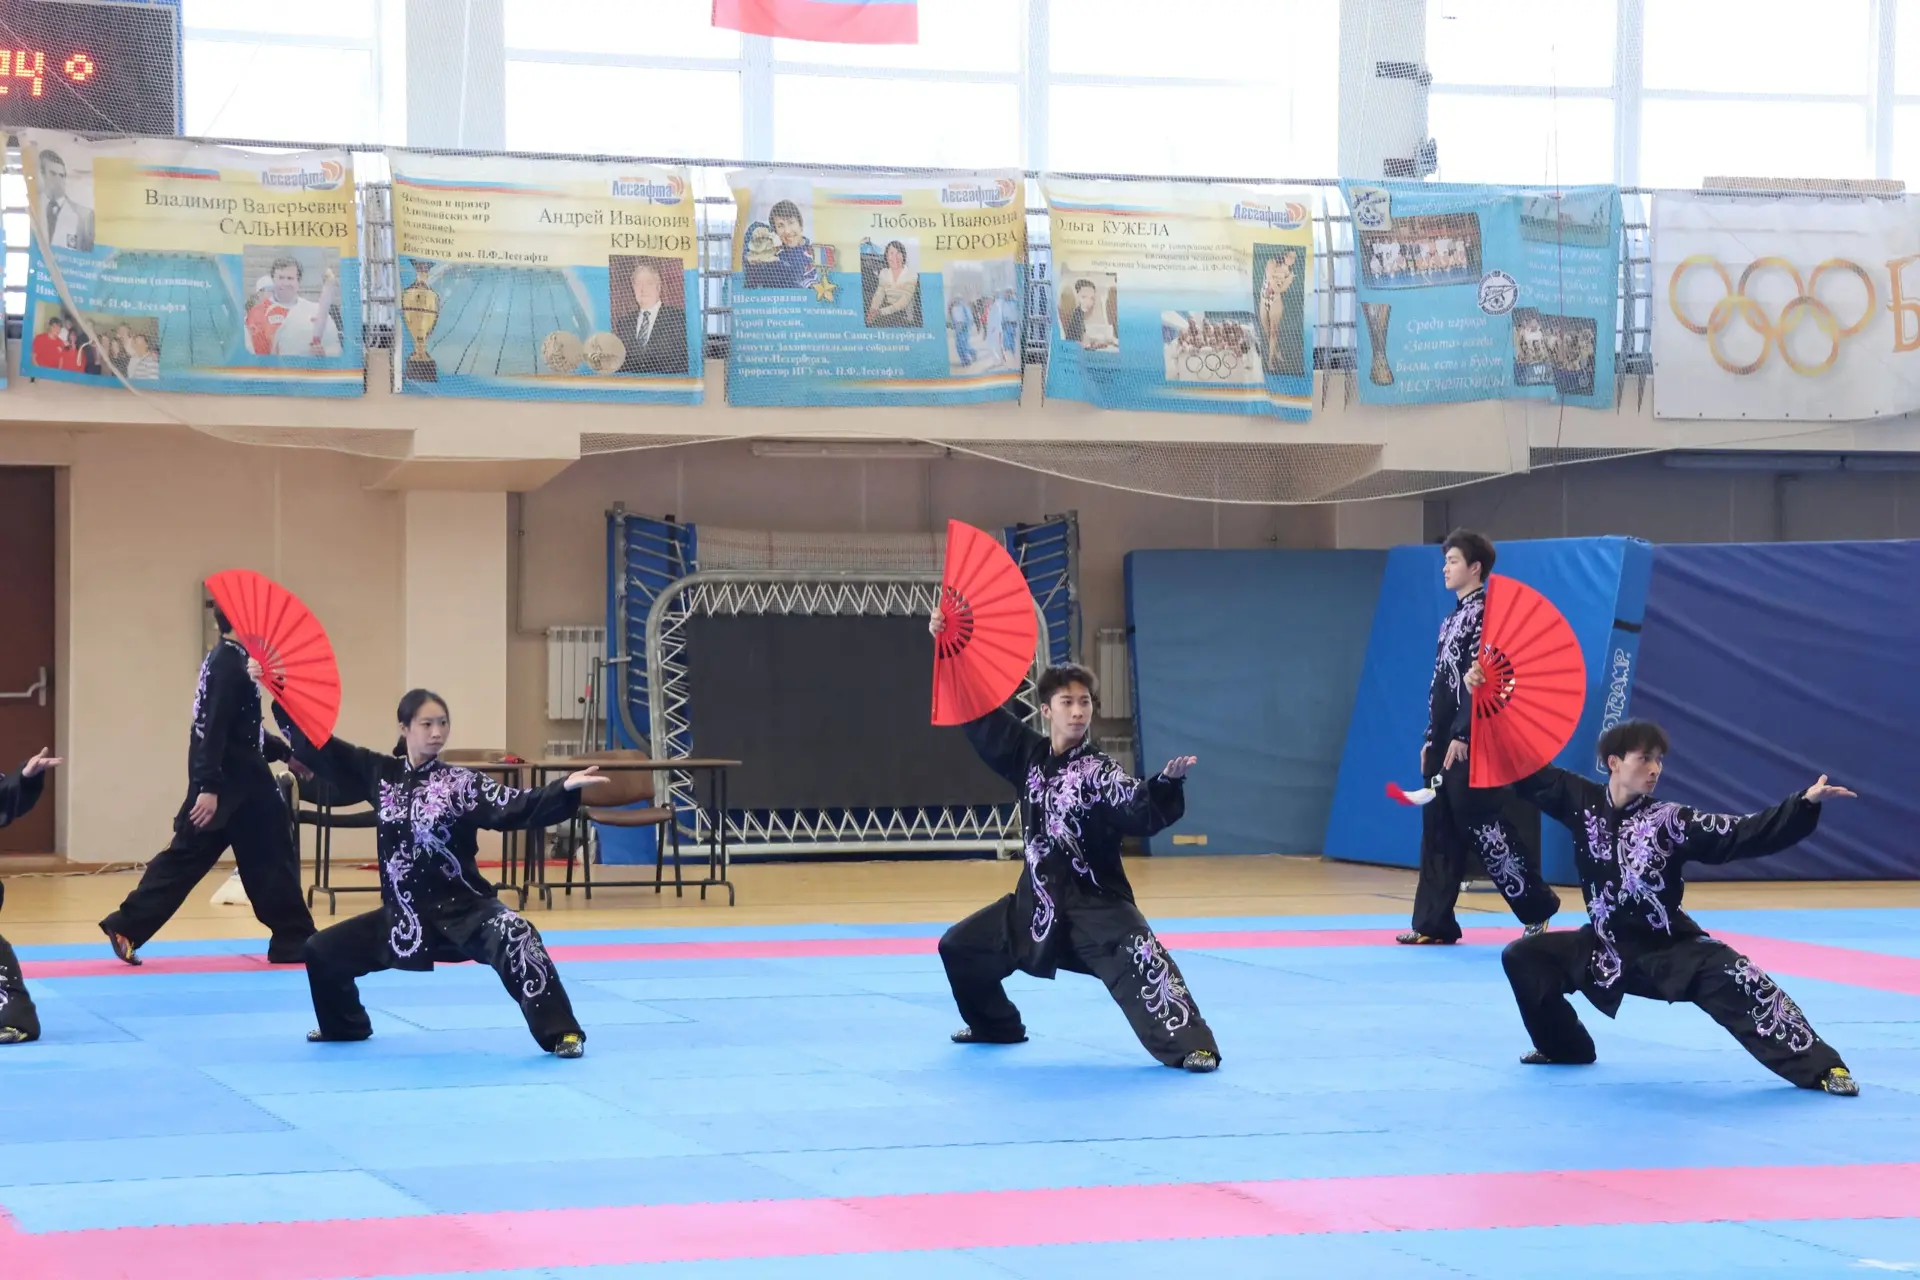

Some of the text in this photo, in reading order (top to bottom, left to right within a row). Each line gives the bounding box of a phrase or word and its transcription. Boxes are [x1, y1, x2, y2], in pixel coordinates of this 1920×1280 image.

[145, 189, 347, 217] Владимир Валерьевич
[219, 218, 349, 238] САЛЬНИКОВ
[538, 208, 690, 228] Андрей Иванович
[870, 211, 1018, 229] Любовь Ивановна
[1055, 218, 1170, 236] Ольга КУЖЕЛА
[611, 233, 692, 251] КРЫЛОВ
[935, 230, 1018, 251] ЕГОРОВА
